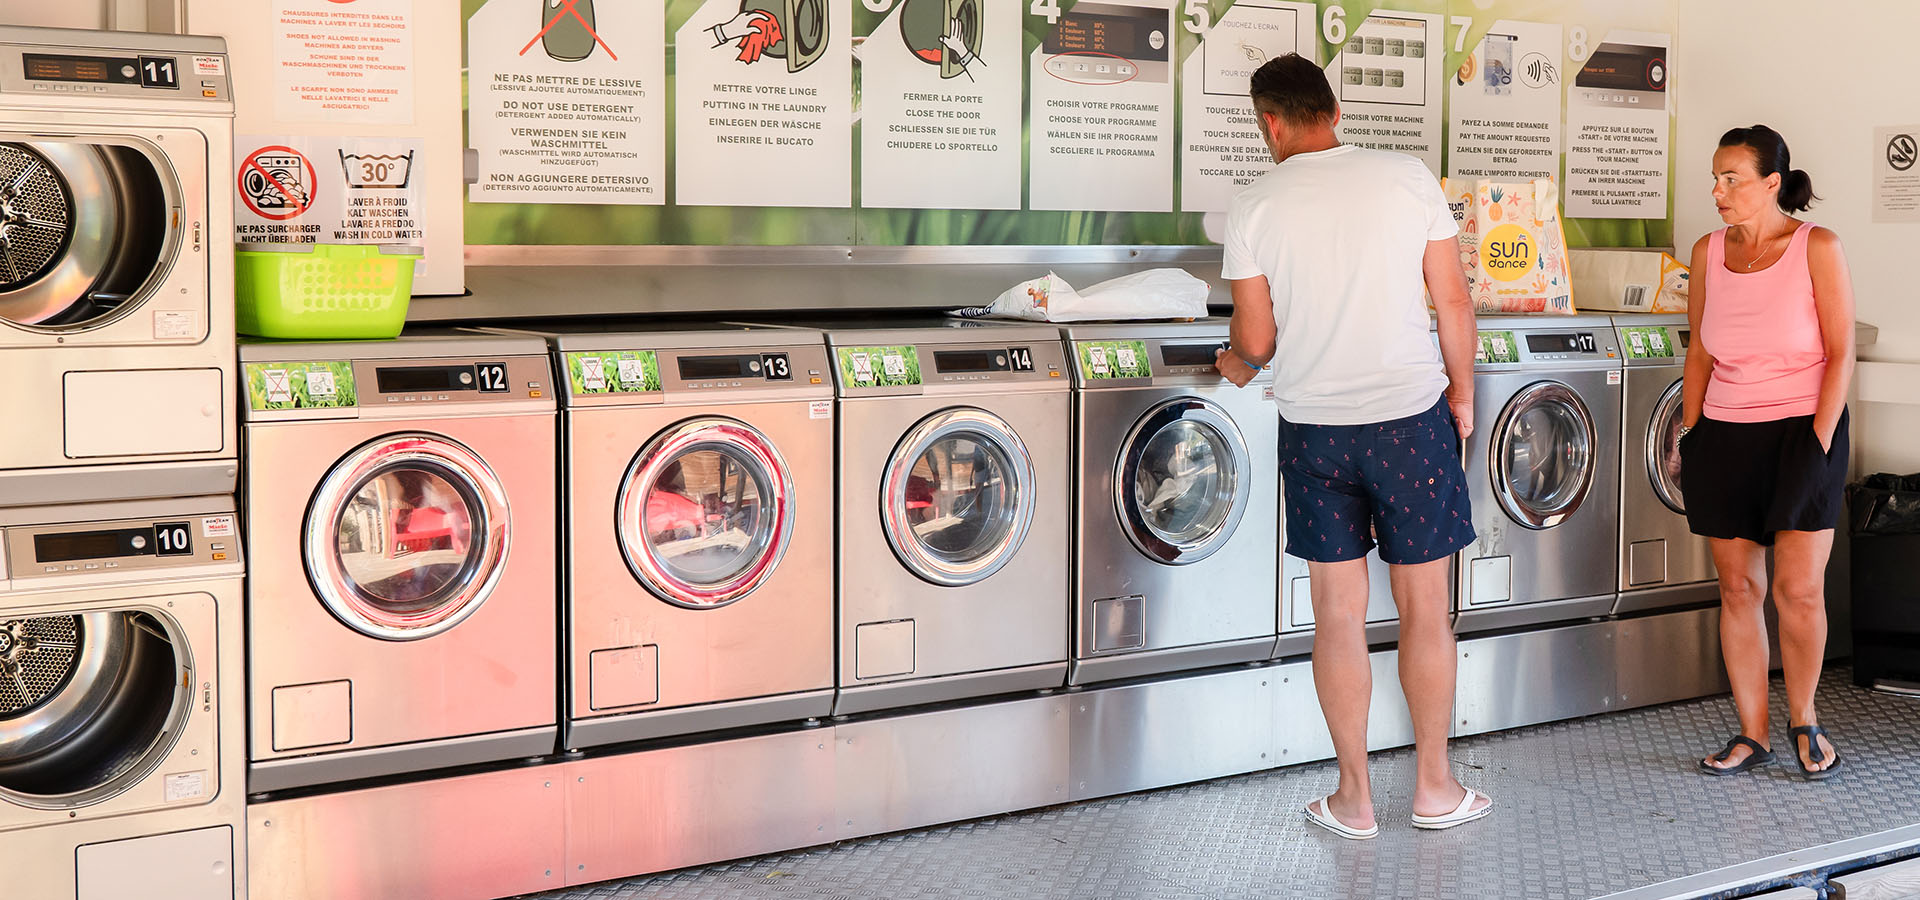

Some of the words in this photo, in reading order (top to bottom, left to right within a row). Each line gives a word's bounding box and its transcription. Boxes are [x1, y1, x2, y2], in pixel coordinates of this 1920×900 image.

[1323, 5, 1346, 44] 6
[1450, 16, 1472, 52] 7
[1568, 26, 1588, 62] 8
[145, 62, 173, 82] 11
[1501, 68, 1511, 84] 20
[495, 74, 509, 83] NE
[512, 75, 533, 84] PAS
[536, 76, 579, 86] METTRE
[582, 77, 596, 86] DE
[599, 78, 642, 88] LESSIVE
[714, 84, 752, 94] METTRE
[755, 86, 786, 95] VOTRE
[789, 87, 818, 96] LINGE
[904, 93, 939, 102] FERMER
[941, 95, 952, 103] LA
[955, 95, 983, 104] PORTE
[503, 101, 518, 110] DO
[522, 102, 544, 111] NOT
[547, 103, 568, 112] USE
[571, 103, 634, 114] DETERGENT
[703, 101, 746, 110] PUTTING
[748, 103, 759, 111] IN
[762, 103, 780, 112] THE
[783, 104, 827, 113] LAUNDRY
[1047, 100, 1080, 109] CHOISIR
[1082, 102, 1108, 110] VOTRE
[1110, 103, 1160, 112] PROGRAMME
[1206, 107, 1240, 116] TOUCHEZ
[496, 111, 545, 120] (DETERGENT
[547, 113, 574, 121] ADDED
[576, 114, 642, 123] AUTOMATICALLY)
[906, 110, 934, 118] CLOSE
[937, 111, 954, 119] THE
[956, 111, 981, 120] DOOR
[1342, 114, 1369, 122] CHOISIR
[1371, 115, 1393, 123] VOTRE
[1394, 116, 1424, 124] MACHINE
[709, 118, 757, 128] EINLEGEN
[760, 120, 779, 128] DER
[1049, 116, 1082, 124] CHOOSE
[1084, 117, 1106, 125] YOUR
[1108, 118, 1157, 127] PROGRAMME
[1482, 120, 1491, 128] LA
[511, 128, 578, 138] VERWENDEN
[582, 130, 598, 139] SIE
[601, 131, 627, 140] KEIN
[889, 125, 943, 134] SCHLIESSEN
[946, 127, 960, 135] SIE
[962, 127, 976, 135] DIE
[979, 126, 997, 136] TÜR
[1343, 128, 1371, 136] CHOOSE
[1392, 130, 1422, 138] MACHINE
[717, 136, 762, 145] INSERIRE
[764, 137, 773, 145] IL
[776, 137, 814, 146] BUCATO
[1473, 133, 1485, 141] THE
[1487, 134, 1513, 142] AMOUNT
[1515, 135, 1551, 143] REQUESTED
[531, 139, 608, 150] WASCHMITTEL
[887, 141, 932, 150] CHIUDERE
[948, 143, 998, 152] SPORTELLO
[1190, 143, 1230, 153] BERÜHREN
[1232, 146, 1244, 154] SIE
[1377, 143, 1394, 151] IHRE
[1395, 144, 1429, 152] MASCHINE
[500, 149, 559, 157] (WASCHMITTEL
[583, 151, 638, 159] AUTOMATISCH
[1050, 147, 1094, 155] SCEGLIERE
[1096, 148, 1104, 156] IL
[1106, 148, 1156, 157] PROGRAMMA
[1233, 155, 1244, 163] ZU
[1245, 156, 1273, 164] STARTE
[362, 163, 394, 182] 30°
[1200, 169, 1234, 177] TOCCARE
[491, 174, 514, 183] NON
[518, 174, 588, 184] AGGIUNGERE
[591, 175, 649, 185] DETERSIVO
[483, 184, 530, 192] (DETERSIVO
[532, 185, 574, 193] AGGIUNTO
[575, 186, 654, 194] AUTOMATICAMENTE)
[348, 198, 372, 206] LAVER
[383, 198, 407, 206] FROID
[369, 209, 408, 217] WASCHEN
[237, 225, 248, 233] NE
[250, 225, 265, 233] PAS
[267, 225, 320, 233] SURCHARGER
[342, 220, 372, 228] LAVARE
[375, 220, 380, 228] A
[383, 220, 414, 228] FREDDO
[269, 234, 316, 243] ÜBERLADEN
[334, 231, 358, 239] WASH
[361, 231, 369, 239] IN
[1489, 259, 1527, 268] dance
[1580, 336, 1594, 350] 17
[1012, 350, 1032, 370] 14
[764, 358, 789, 376] 13
[480, 366, 505, 390] 12
[159, 528, 188, 550] 10
